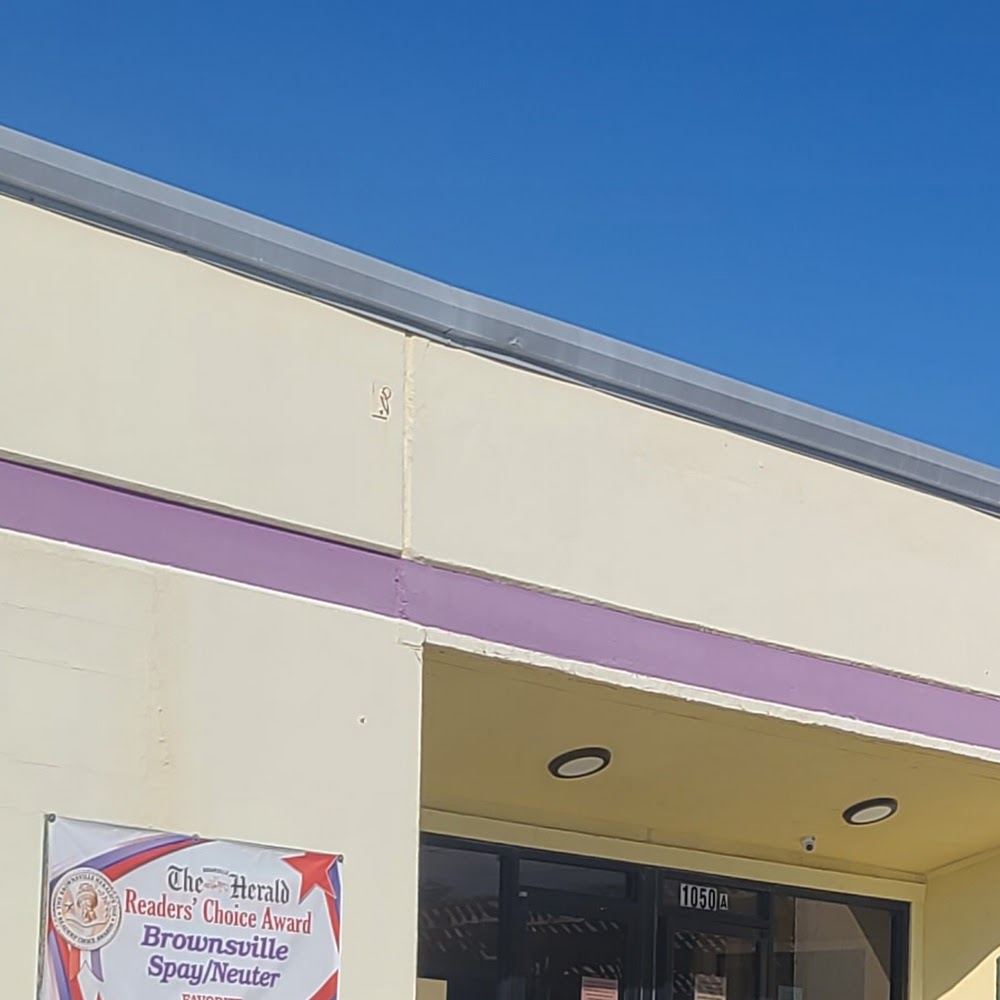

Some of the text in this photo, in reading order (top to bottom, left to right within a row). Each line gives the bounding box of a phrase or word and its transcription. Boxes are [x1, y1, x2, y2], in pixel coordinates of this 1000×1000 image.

[167, 865, 290, 904] The Herald
[682, 884, 716, 909] 1050
[203, 899, 257, 928] Choice
[261, 906, 311, 934] Award
[141, 925, 289, 961] Brownsville
[148, 955, 280, 988] Spay/Neuter
